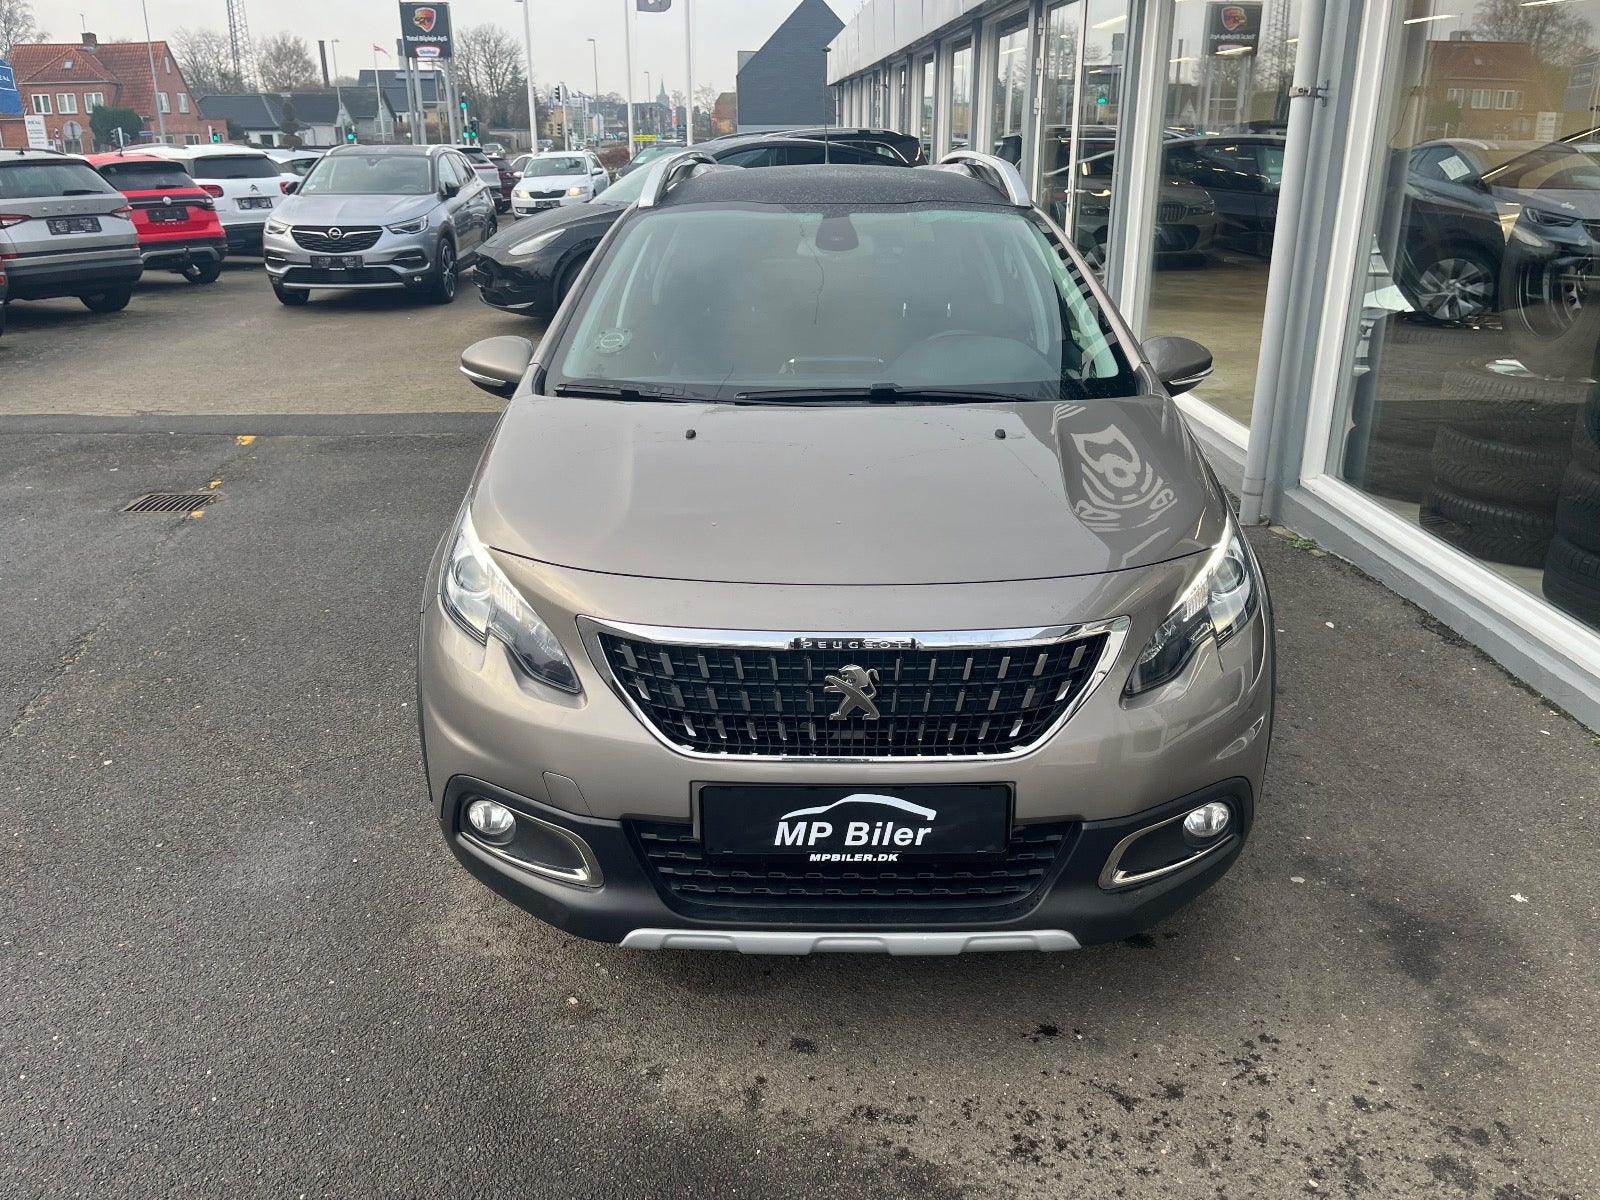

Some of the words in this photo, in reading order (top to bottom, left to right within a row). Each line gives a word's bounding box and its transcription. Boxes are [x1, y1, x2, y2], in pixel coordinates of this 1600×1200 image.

[801, 640, 906, 649] PEUGEOT
[774, 822, 833, 846] MP
[844, 821, 932, 846] Biler
[809, 853, 899, 862] MPBILER.DK
